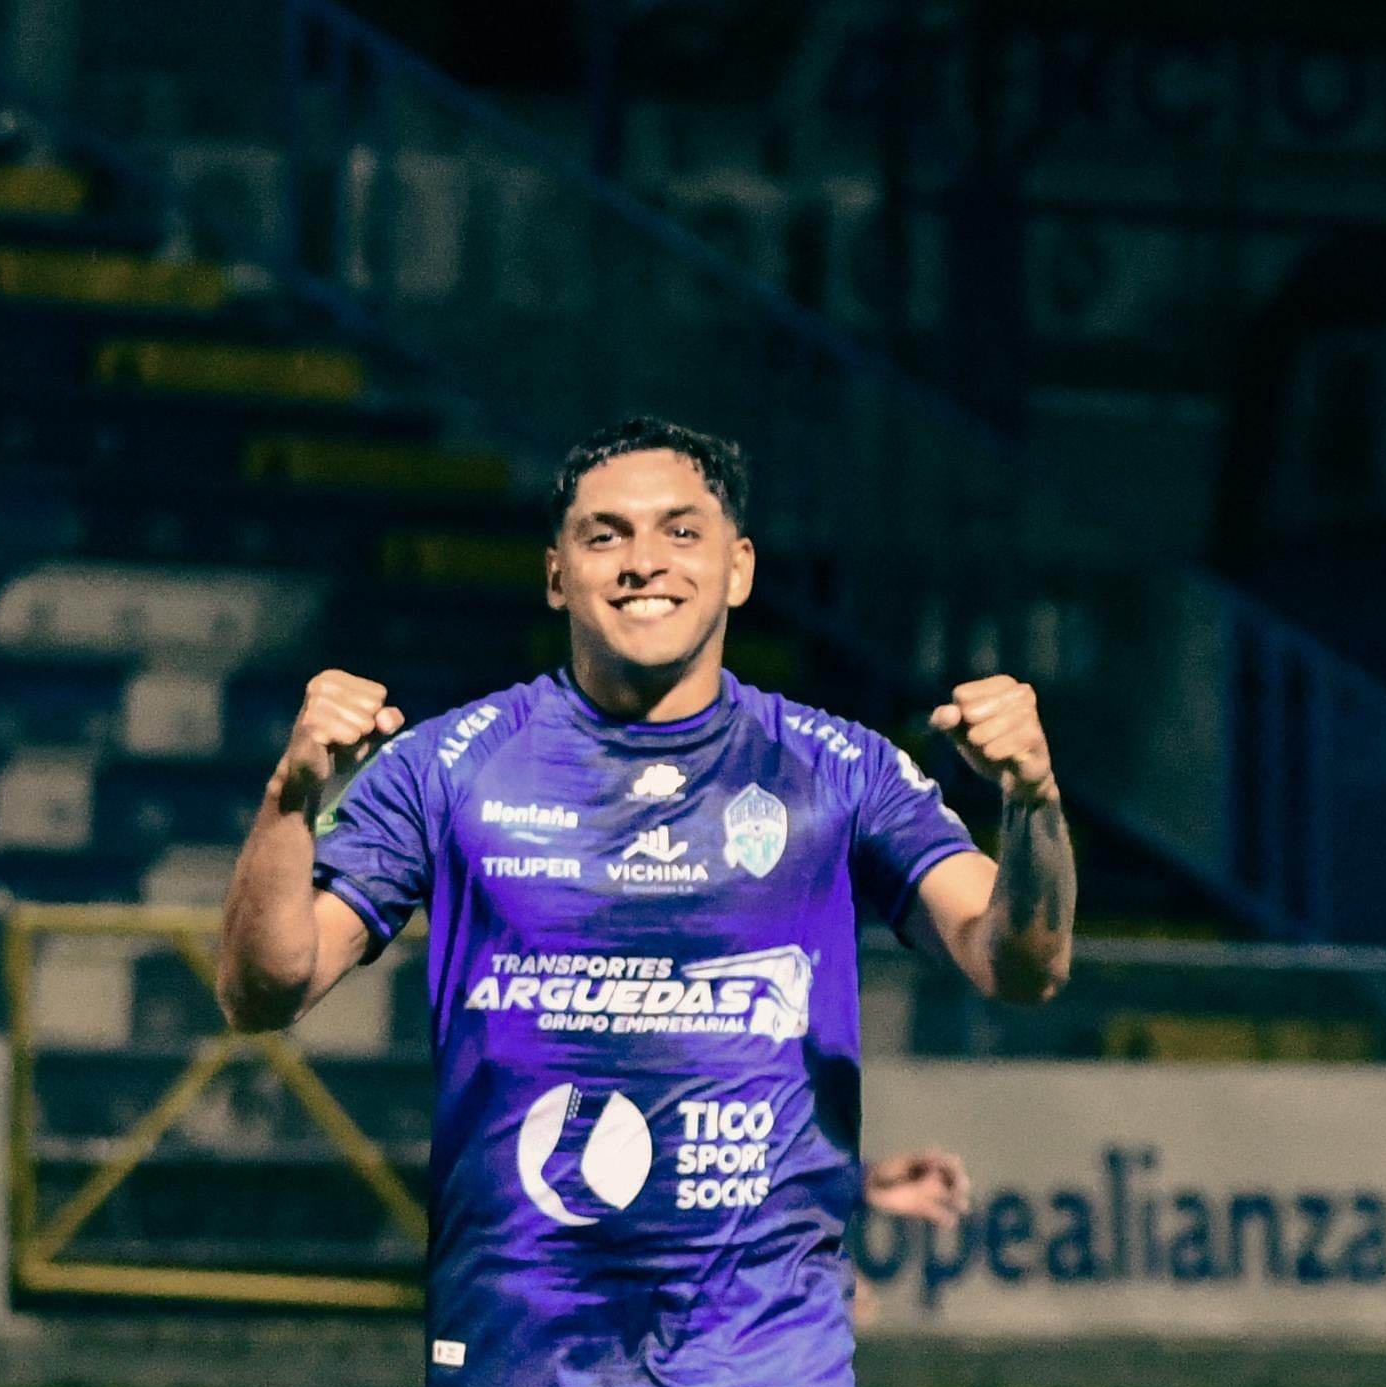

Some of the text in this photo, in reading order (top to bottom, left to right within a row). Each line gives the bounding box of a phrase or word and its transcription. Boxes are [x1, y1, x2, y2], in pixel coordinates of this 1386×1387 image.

[482, 856, 581, 878] TRUPER
[606, 863, 709, 882] VICHIMA
[492, 954, 673, 980] TRANSPORTES
[464, 976, 755, 1015] ARGUEDAS
[538, 1012, 747, 1035] GRUPO EMPRESARIAL
[677, 1100, 774, 1141] TICO
[676, 1143, 770, 1174] SPORT
[675, 1177, 770, 1210] SOCKS
